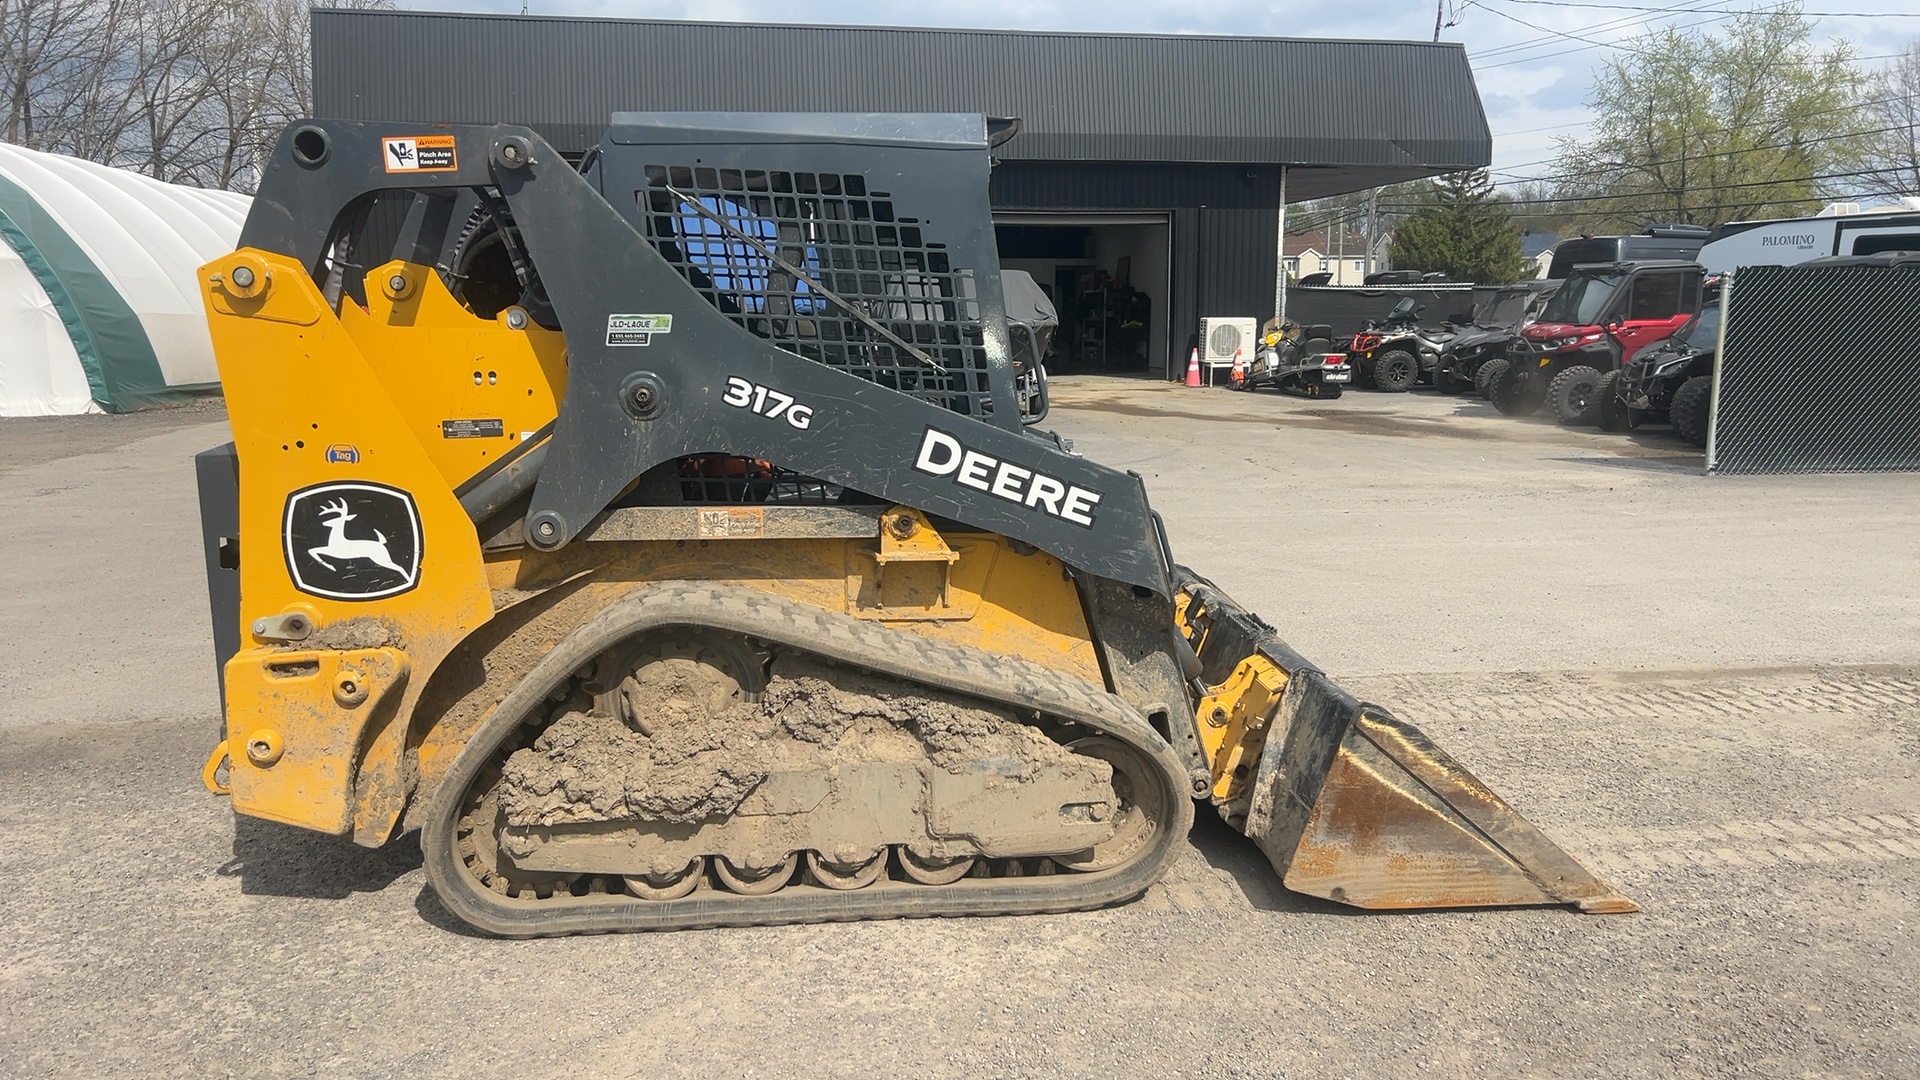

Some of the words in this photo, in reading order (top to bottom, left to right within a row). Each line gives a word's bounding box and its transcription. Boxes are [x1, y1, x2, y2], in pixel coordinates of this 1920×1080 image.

[1762, 234, 1815, 246] PALOMINO
[609, 320, 651, 328] JLD-LAGUE
[722, 376, 815, 430] 317G
[334, 450, 352, 462] Tag
[915, 428, 1101, 526] DEERE
